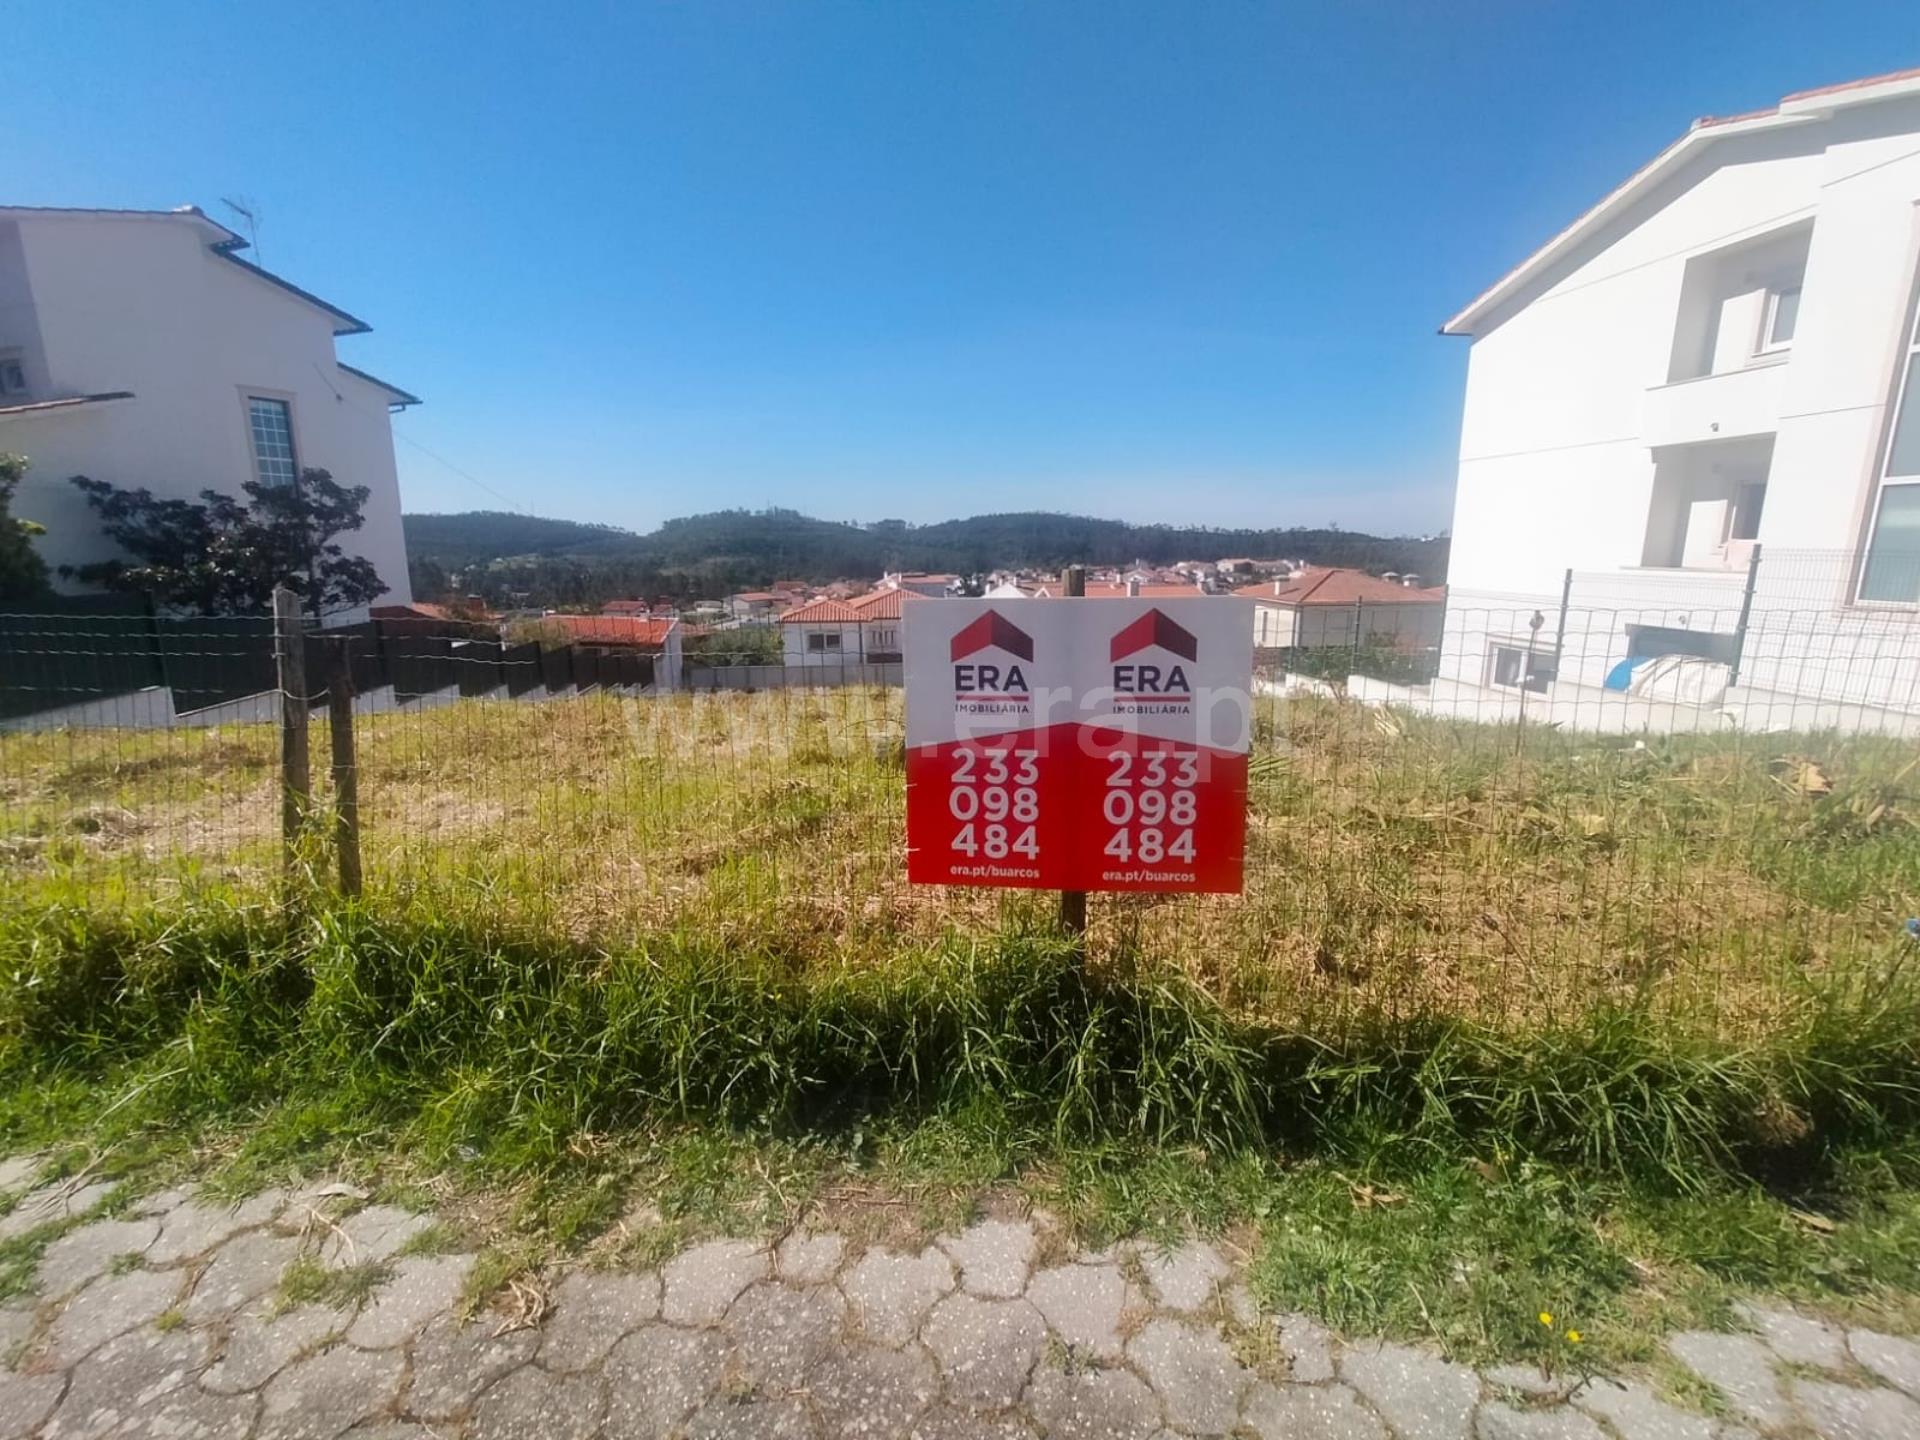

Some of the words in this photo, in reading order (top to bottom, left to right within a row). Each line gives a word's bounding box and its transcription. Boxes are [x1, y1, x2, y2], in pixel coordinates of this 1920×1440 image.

[955, 665, 1029, 692] ERA
[1113, 665, 1190, 693] ERA
[954, 703, 1030, 714] IMOBILIÁRIA
[1112, 703, 1191, 715] IMOBILIÁRIA
[951, 748, 1039, 784] 233
[1106, 751, 1198, 788] 233
[949, 786, 1040, 823] 098
[1103, 790, 1198, 826] 098
[951, 824, 1040, 860] 484
[1103, 828, 1197, 865] 484
[950, 865, 1041, 879] era.pt/buarcos
[1102, 870, 1196, 883] era.pt/buarcos
